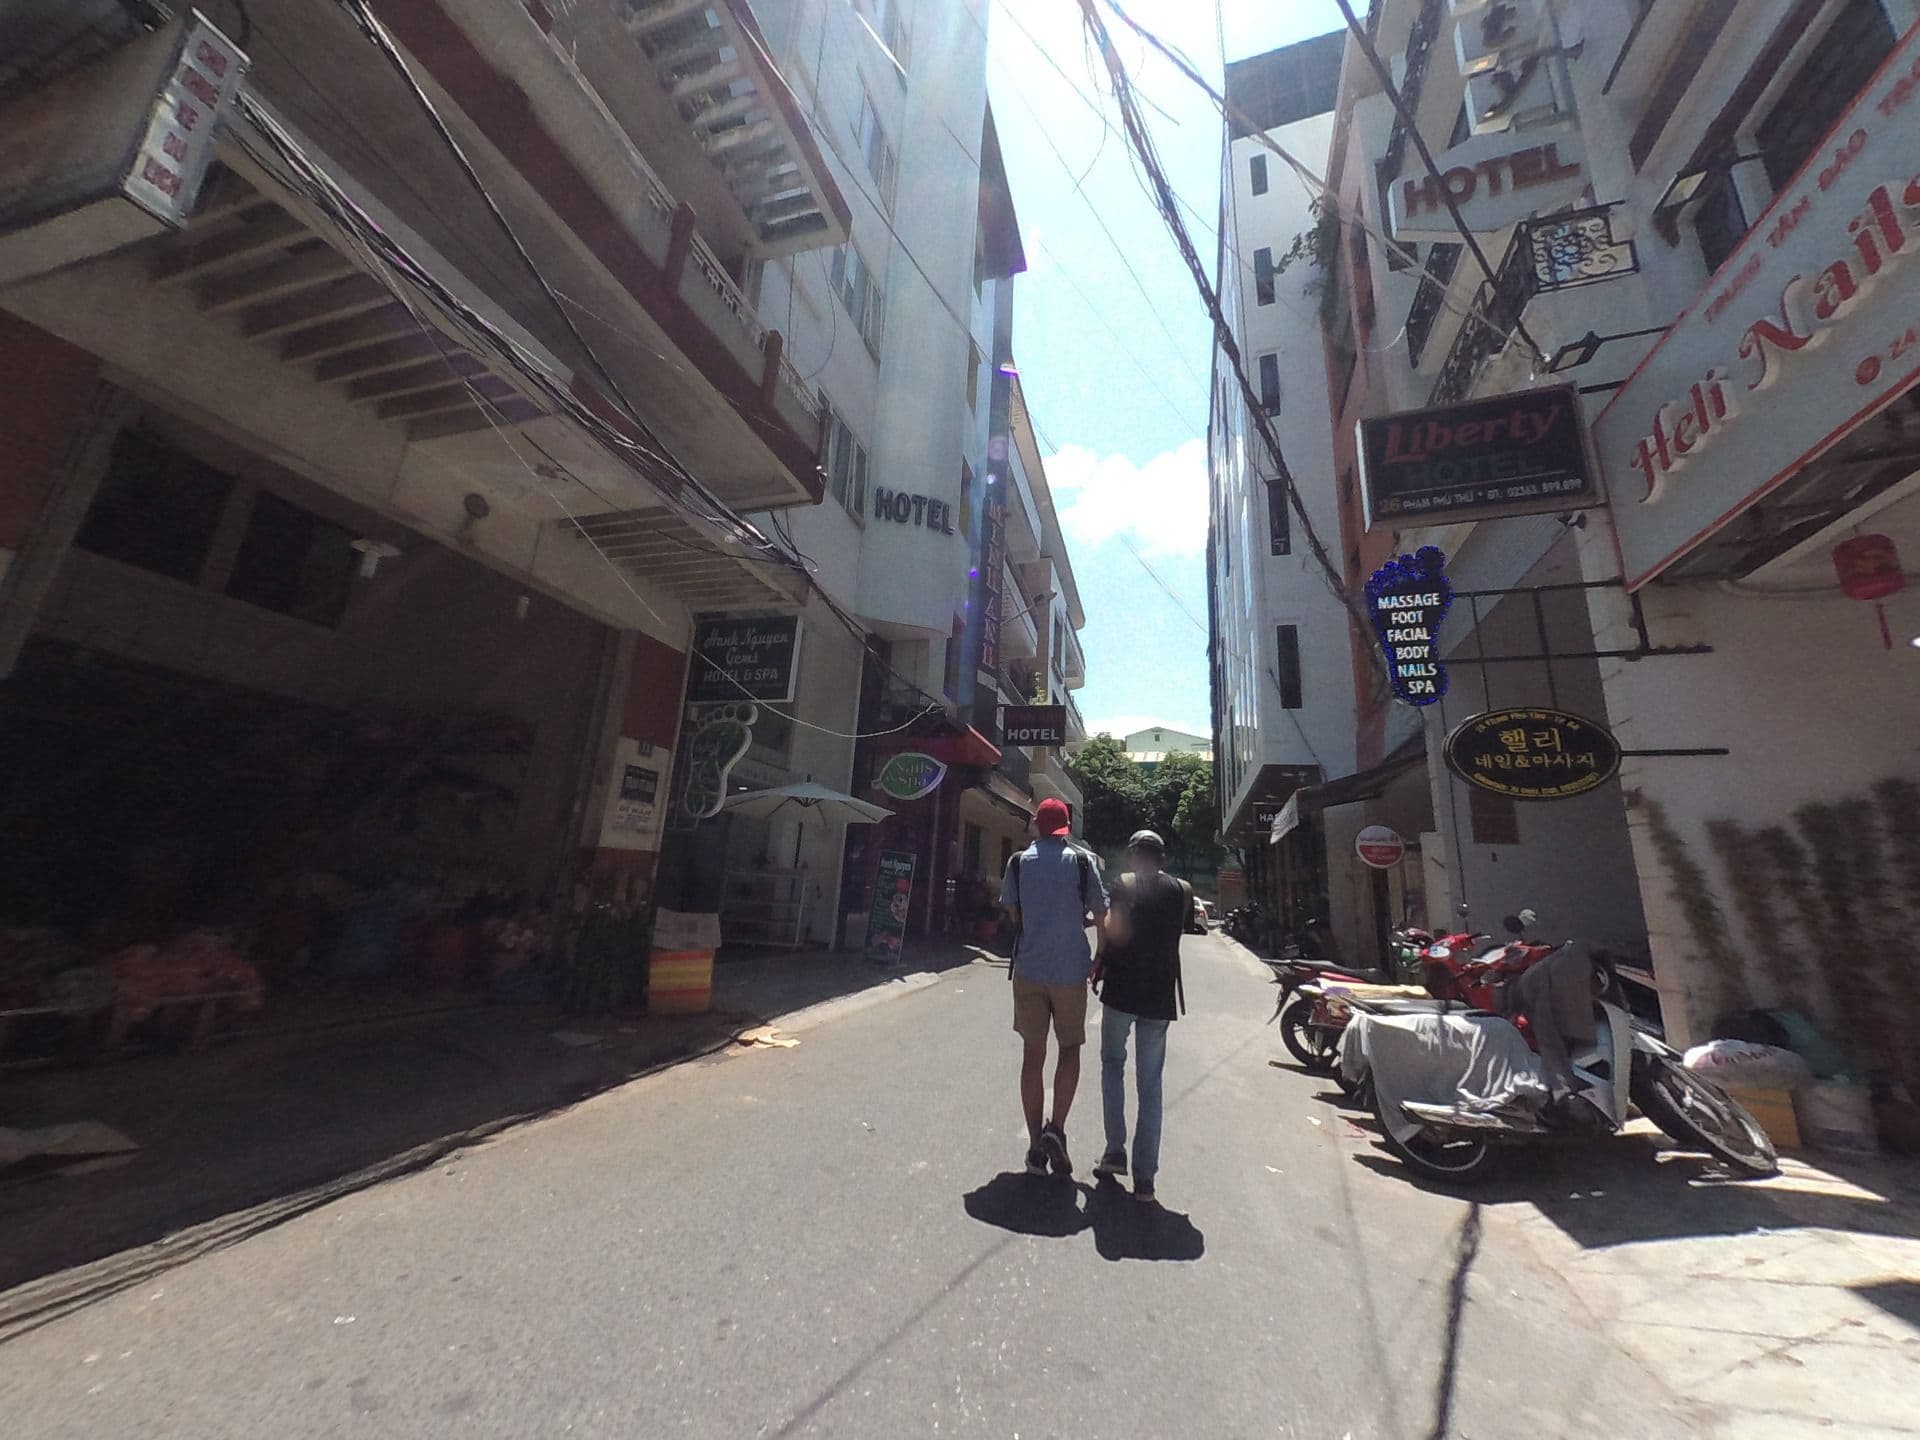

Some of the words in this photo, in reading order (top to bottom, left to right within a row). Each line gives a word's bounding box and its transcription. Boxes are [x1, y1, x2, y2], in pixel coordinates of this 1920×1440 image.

[1404, 143, 1581, 218] HOTEL
[1383, 404, 1562, 464] Liberty
[1630, 369, 1728, 503] Heli
[1407, 452, 1545, 487] HOTEL
[875, 486, 955, 535] HOTEL
[1377, 593, 1440, 609] MASSAGE
[1391, 611, 1423, 625] FOOT
[1387, 627, 1431, 642] FACIAL
[1396, 646, 1430, 660] BODY
[704, 667, 739, 681] HOTEL
[754, 668, 777, 680] SPA
[1398, 663, 1437, 677] NAILS
[1408, 680, 1435, 694] SPA
[1008, 729, 1060, 740] HOTEL
